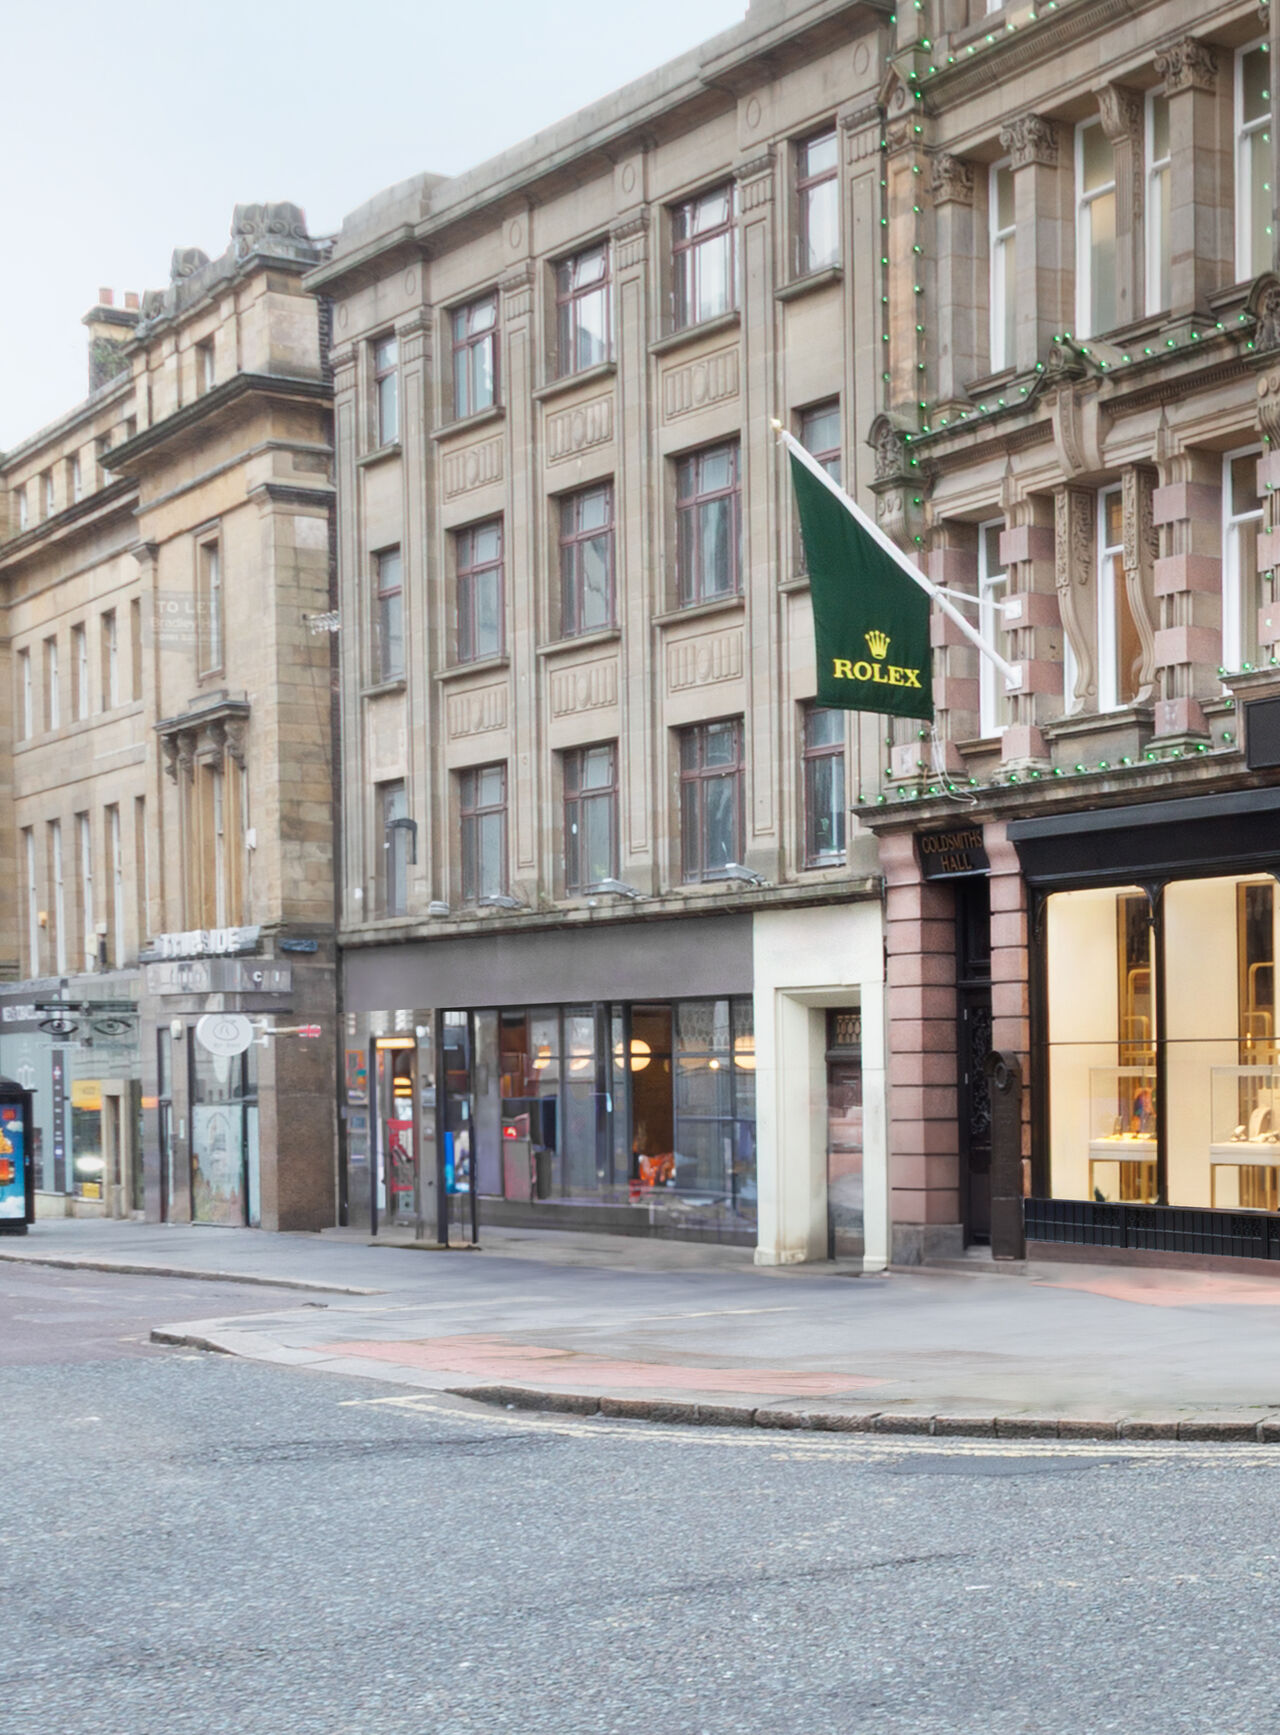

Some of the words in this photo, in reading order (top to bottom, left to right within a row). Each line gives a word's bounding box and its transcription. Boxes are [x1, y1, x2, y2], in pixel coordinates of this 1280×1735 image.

[157, 600, 178, 613] TO
[832, 658, 922, 688] ROLEX
[940, 853, 973, 871] HALL
